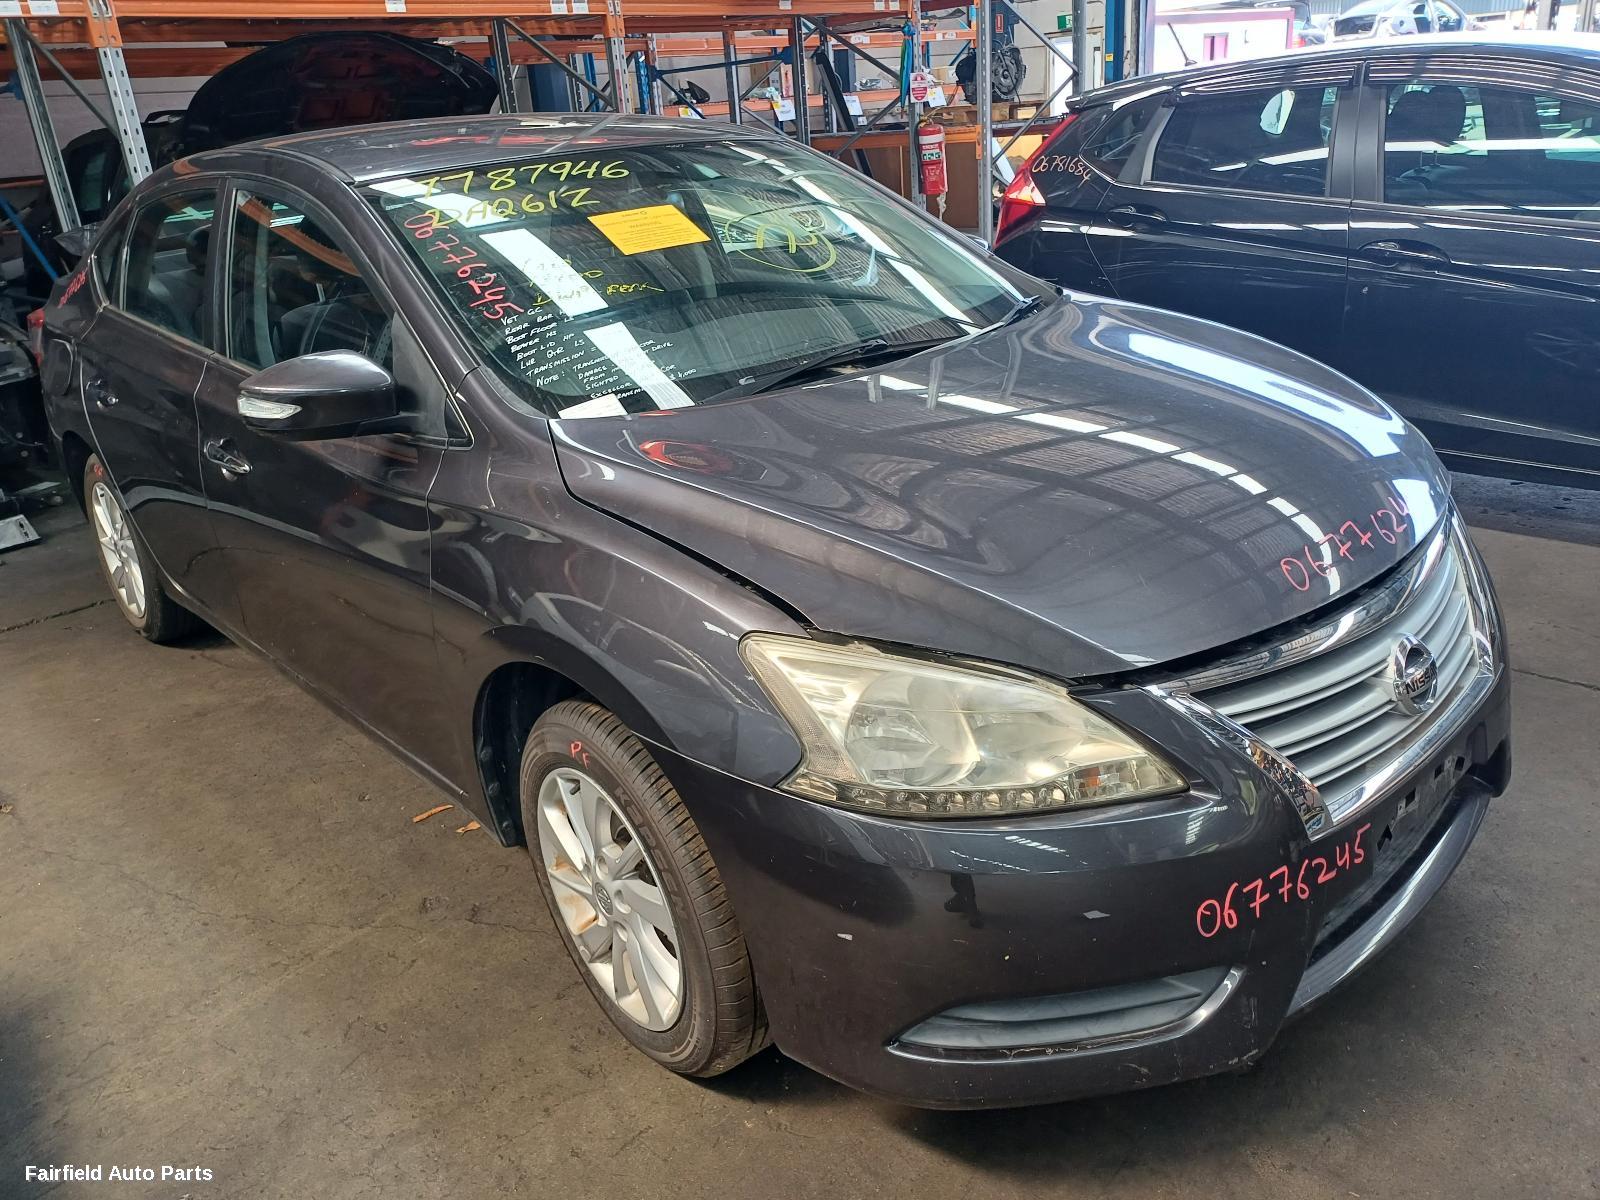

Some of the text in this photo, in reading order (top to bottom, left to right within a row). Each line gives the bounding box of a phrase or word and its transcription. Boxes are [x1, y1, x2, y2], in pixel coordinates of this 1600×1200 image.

[414, 160, 630, 199] 7787946
[1032, 155, 1091, 188] 06781684
[404, 213, 525, 319] 06776245
[1196, 822, 1371, 938] 06776245
